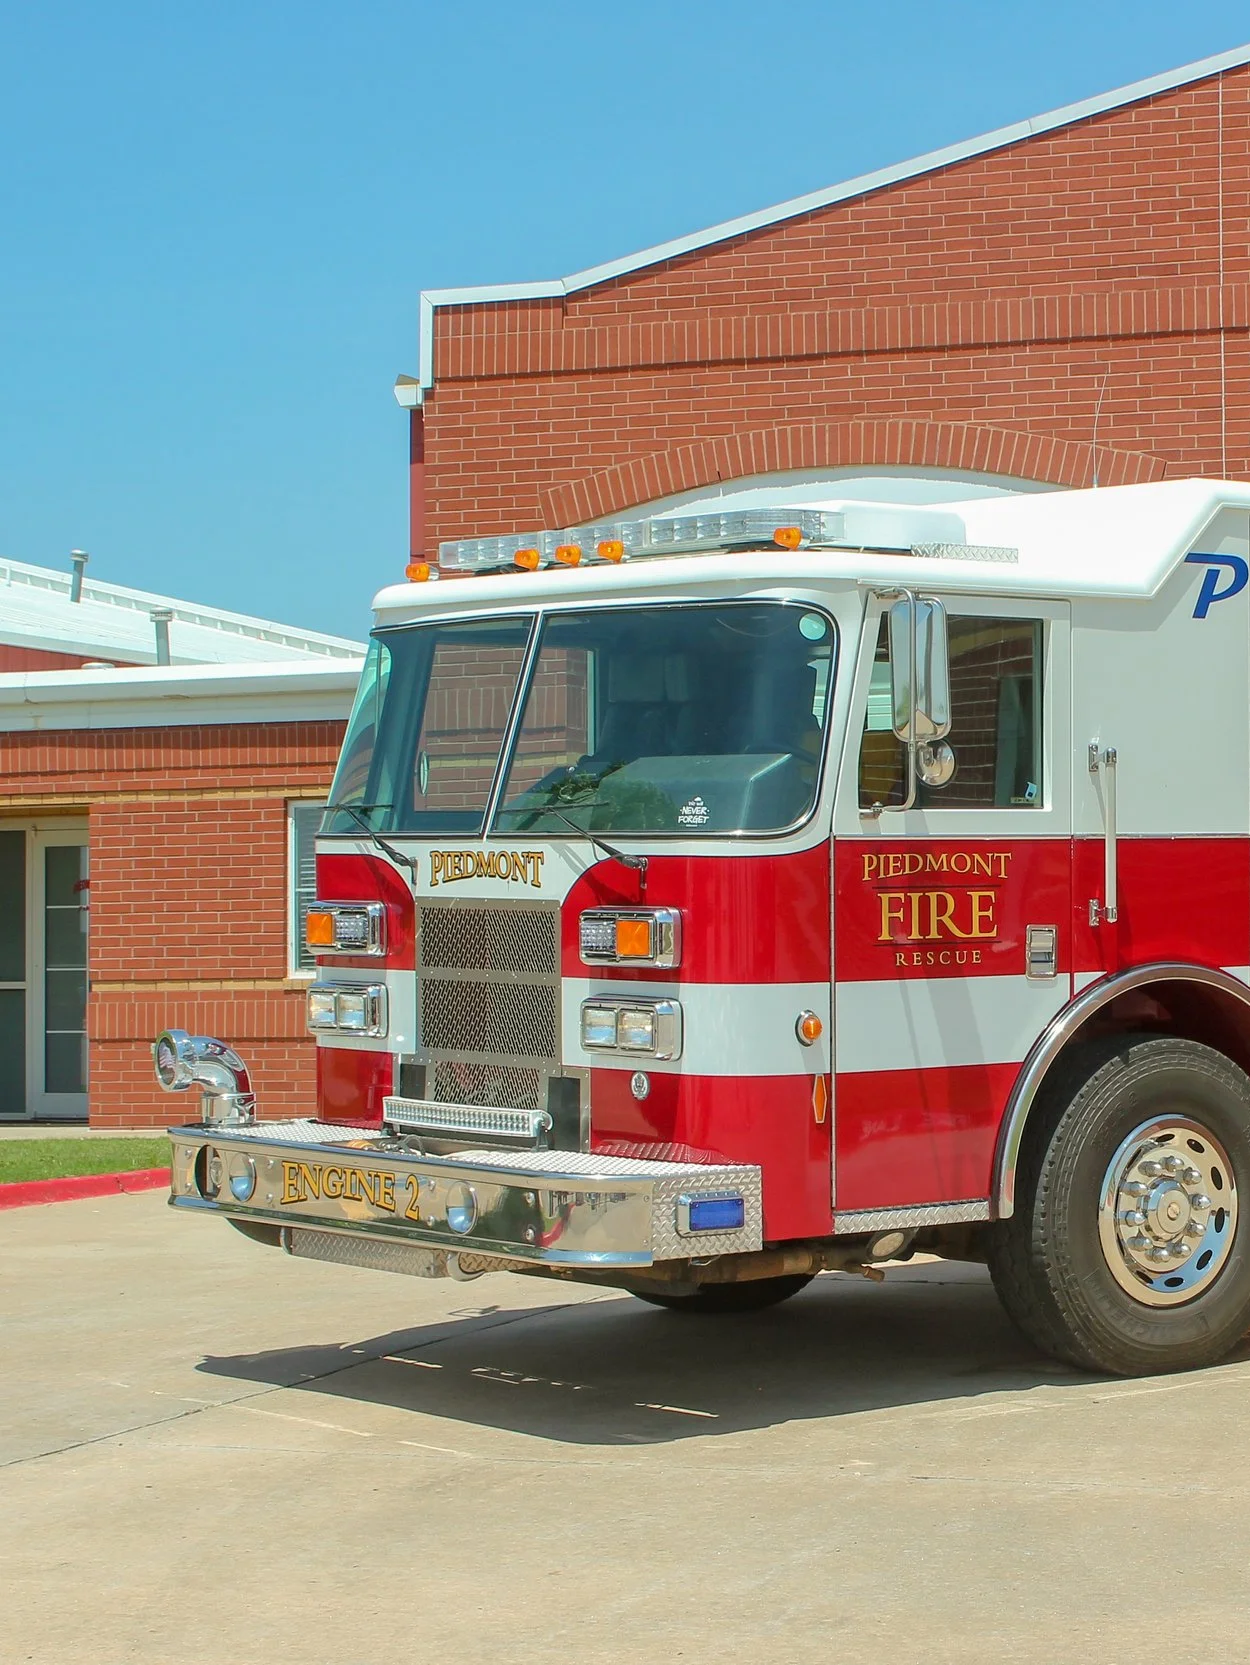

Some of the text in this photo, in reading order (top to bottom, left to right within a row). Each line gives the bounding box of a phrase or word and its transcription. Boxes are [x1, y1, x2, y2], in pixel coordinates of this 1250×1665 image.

[1184, 552, 1249, 619] P
[677, 815, 710, 824] FORGET
[681, 806, 708, 815] NEVER
[430, 851, 545, 888] PIEDMONT
[861, 852, 1013, 882] PIEDMONT
[877, 891, 998, 941] FIRE
[895, 950, 982, 966] RESCUE
[280, 1160, 420, 1221] ENGINE 2
